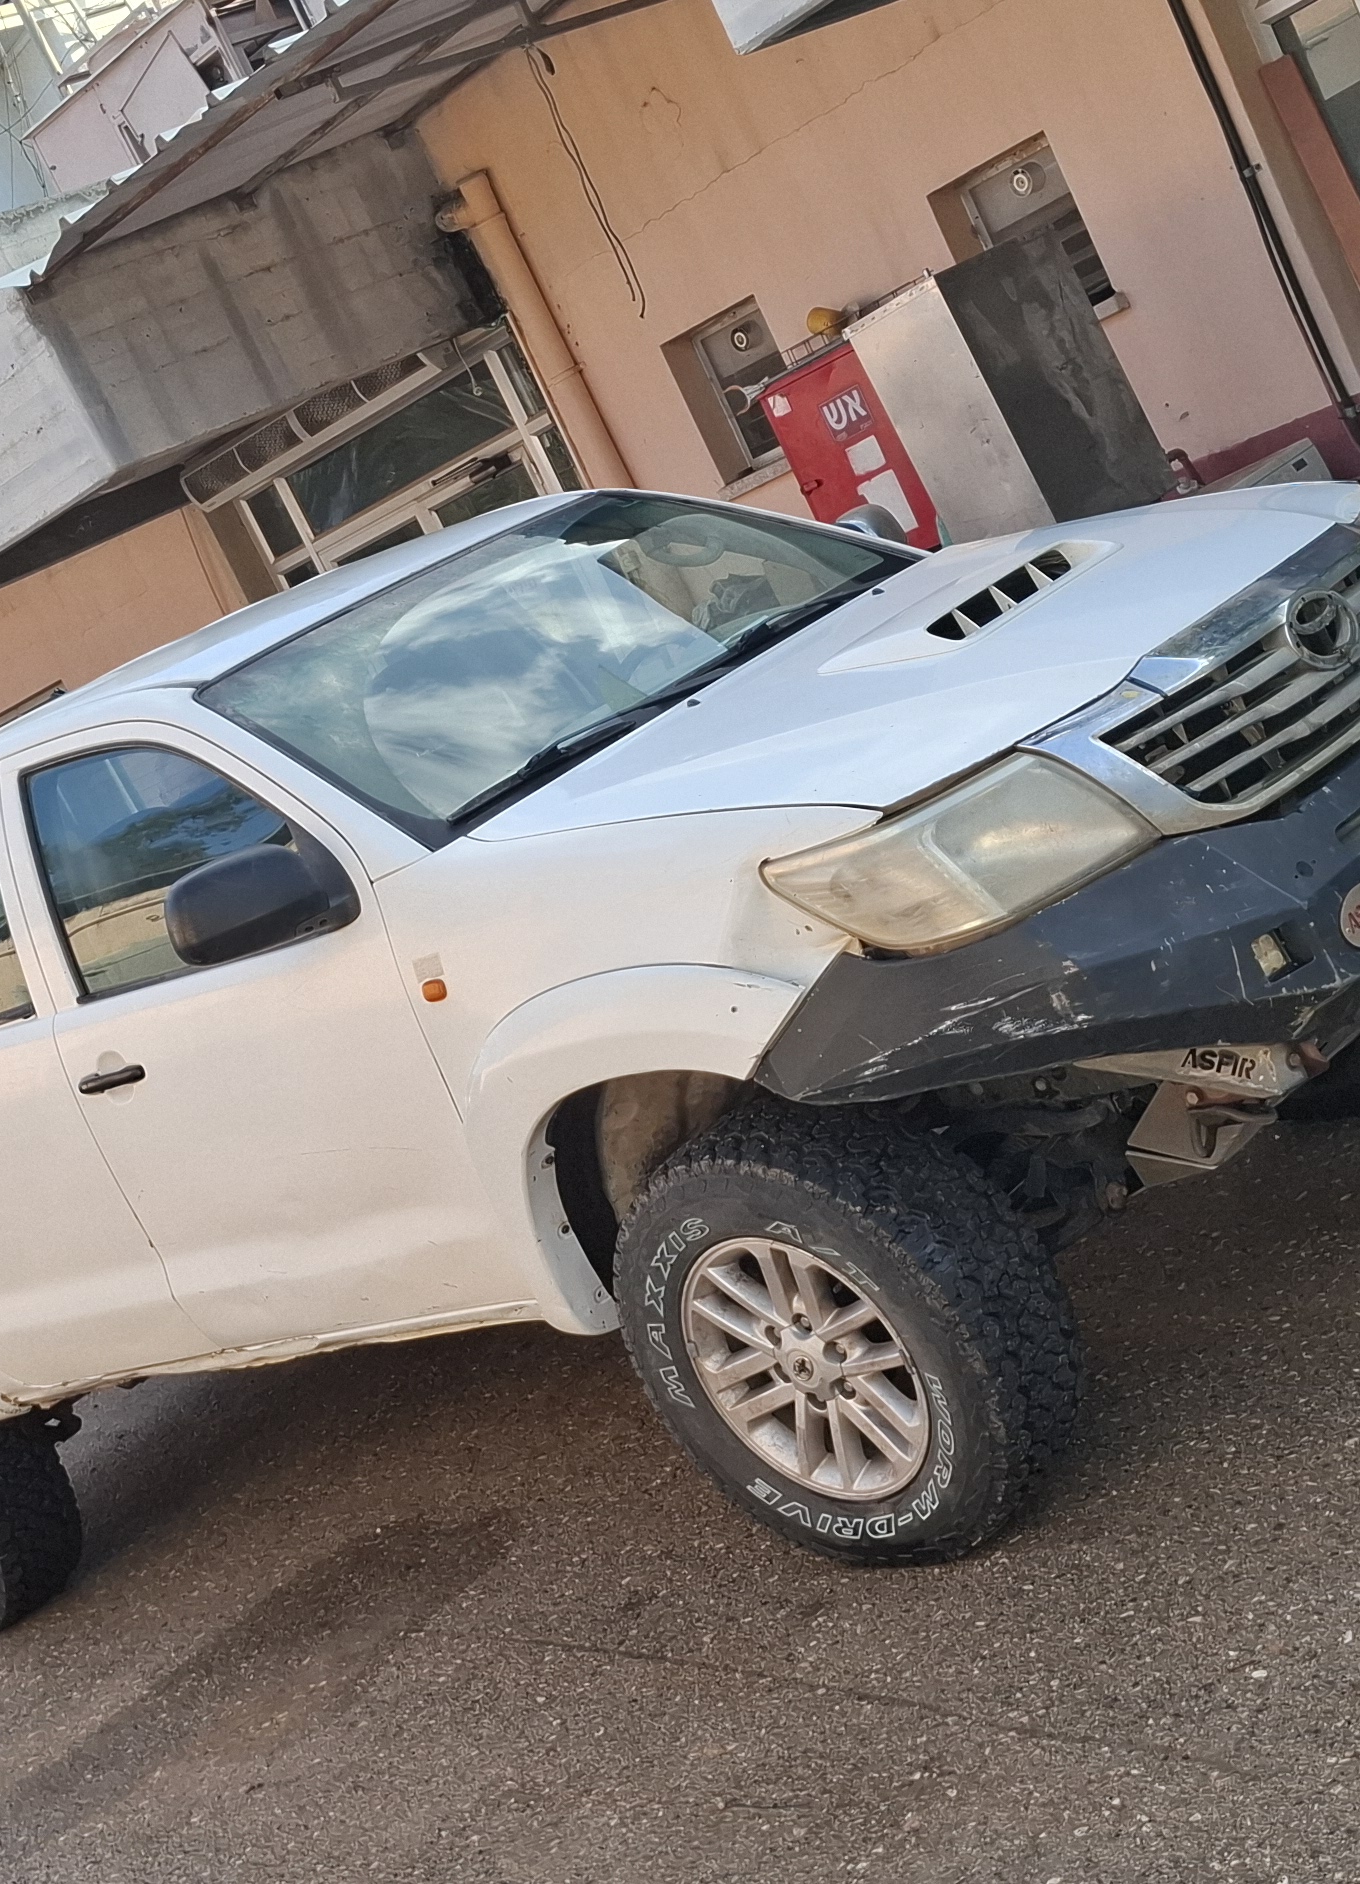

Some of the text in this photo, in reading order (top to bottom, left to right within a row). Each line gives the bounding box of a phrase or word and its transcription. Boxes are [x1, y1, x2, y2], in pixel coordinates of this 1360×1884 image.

[822, 389, 868, 430] אש
[1181, 1048, 1256, 1079] ASFIR
[645, 1218, 710, 1409] MAXXIS
